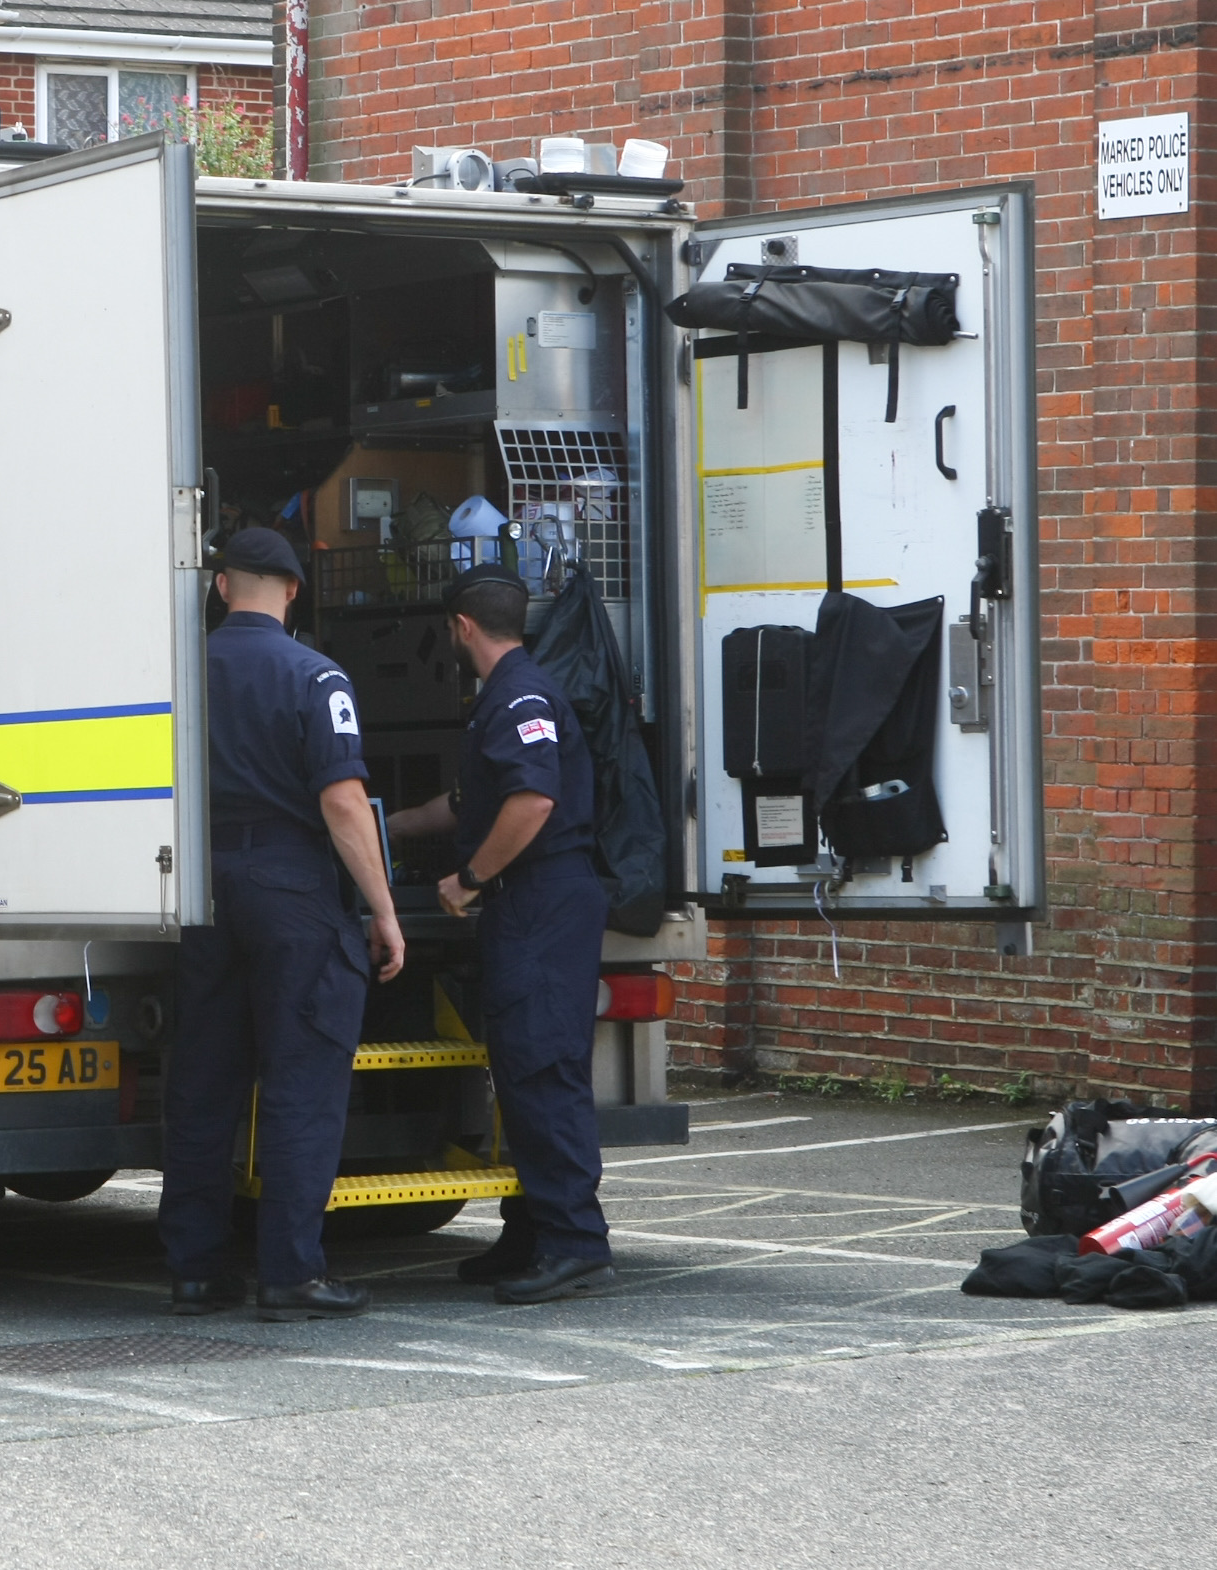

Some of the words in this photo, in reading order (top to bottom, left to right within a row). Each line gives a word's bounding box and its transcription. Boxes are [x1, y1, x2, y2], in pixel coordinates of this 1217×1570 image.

[1100, 137, 1144, 165] MARKED
[1149, 133, 1186, 160] POLICE
[1103, 170, 1153, 198] VEHICLES
[1157, 167, 1185, 194] ONLY
[4, 1049, 46, 1087] 25
[57, 1046, 98, 1084] AB
